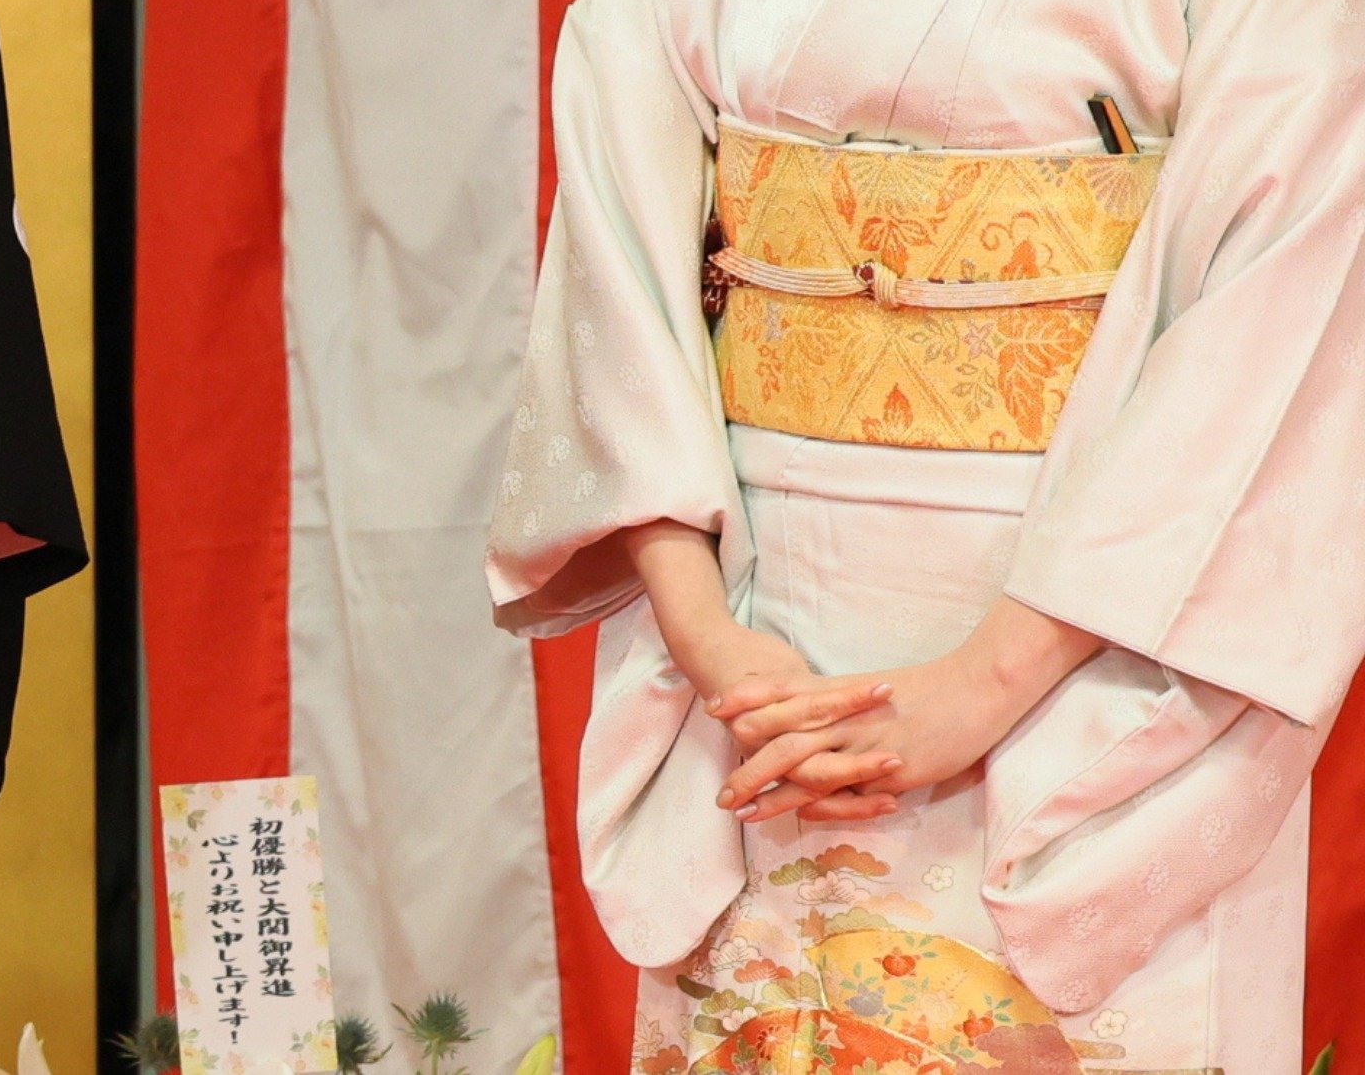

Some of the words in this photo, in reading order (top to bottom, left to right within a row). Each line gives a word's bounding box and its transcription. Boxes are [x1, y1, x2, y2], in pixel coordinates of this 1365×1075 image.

[249, 816, 296, 998] 初優勝と大関御昇進
